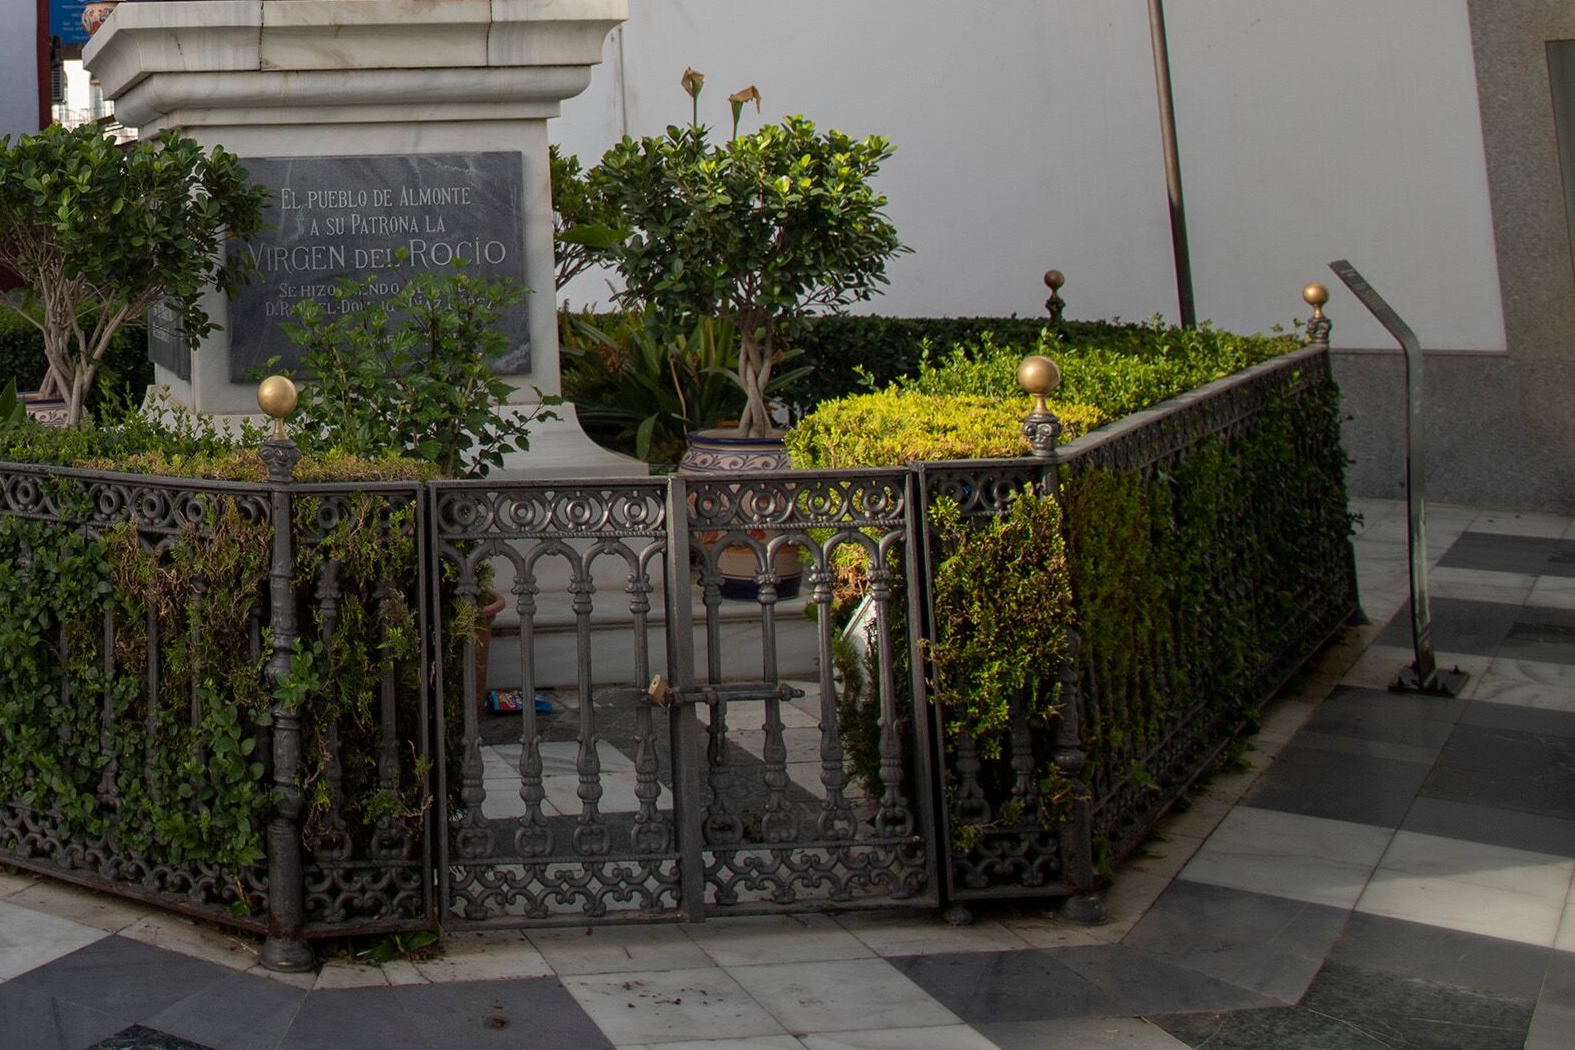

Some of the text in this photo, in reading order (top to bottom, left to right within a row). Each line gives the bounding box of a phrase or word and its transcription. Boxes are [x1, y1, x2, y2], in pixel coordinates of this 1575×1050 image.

[308, 190, 367, 209] PUEBLO
[373, 189, 393, 207] DE
[400, 185, 471, 207] ALMONTE
[310, 213, 446, 237] A SU PATRONA LA
[248, 243, 346, 274] VIRGEN
[409, 237, 506, 269] ROCÍO
[301, 284, 335, 297] HIZO
